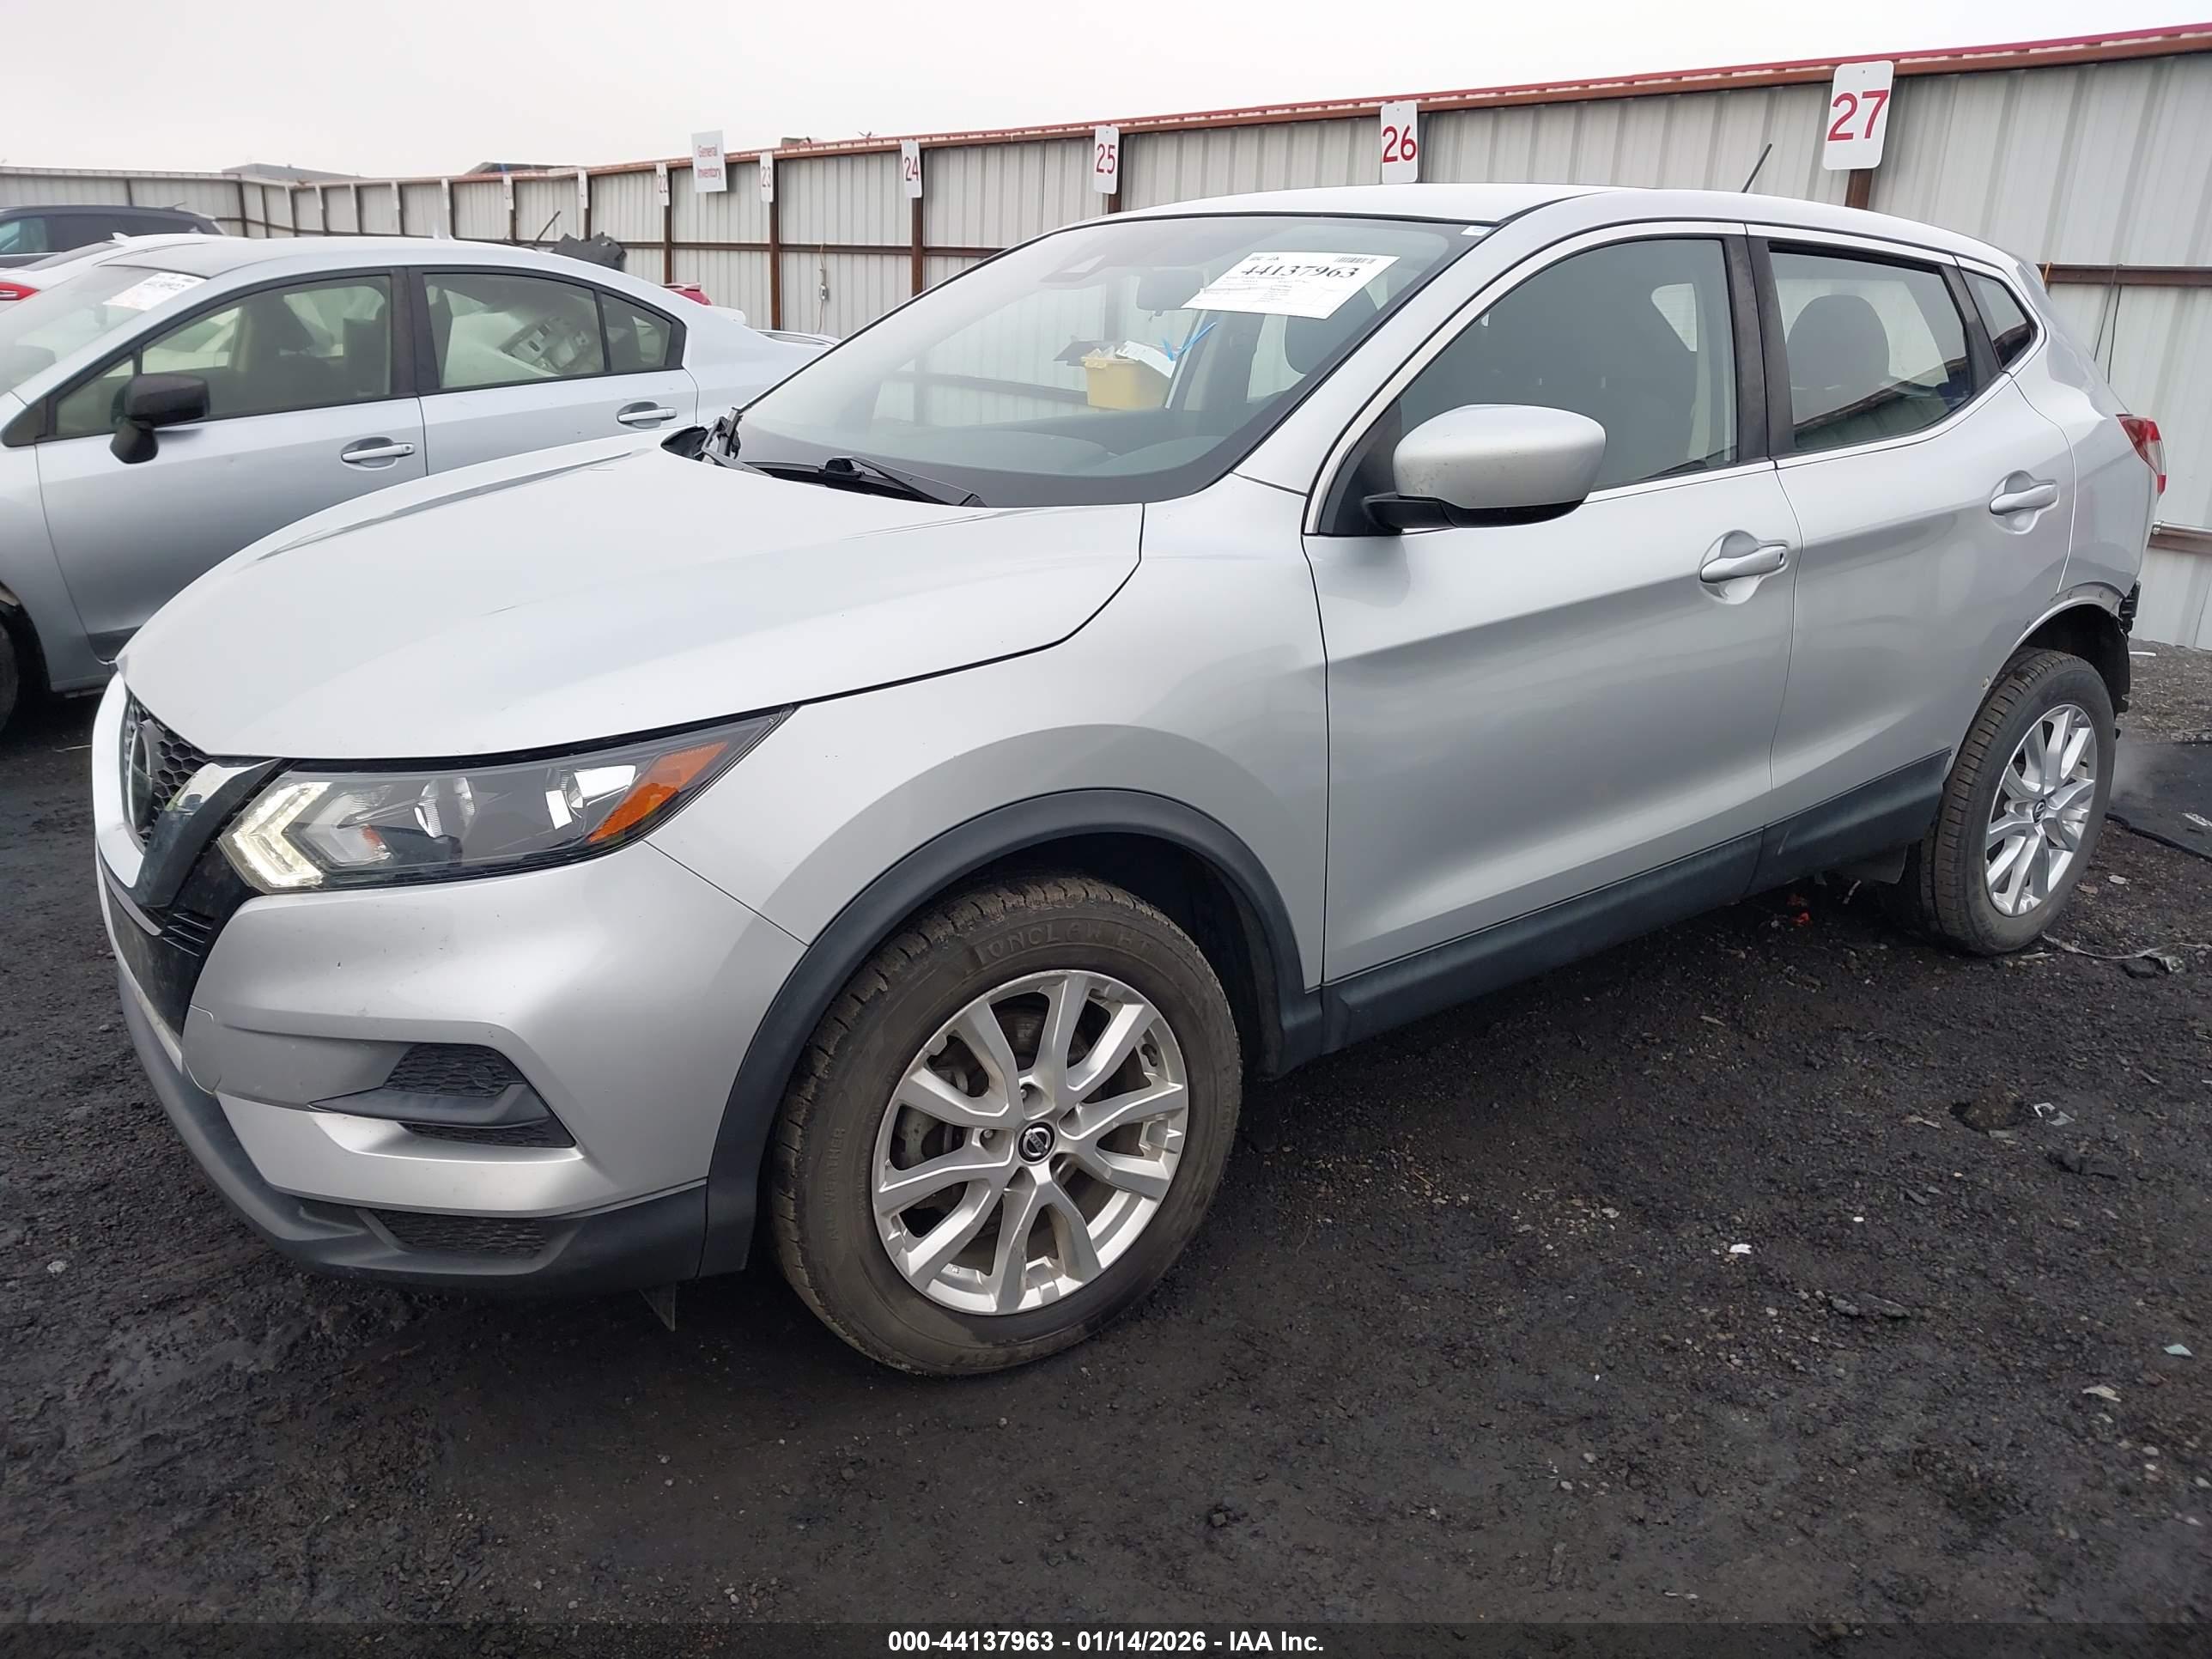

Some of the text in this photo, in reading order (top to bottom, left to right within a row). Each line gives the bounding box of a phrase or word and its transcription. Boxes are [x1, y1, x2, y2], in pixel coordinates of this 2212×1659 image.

[1827, 89, 1889, 141] 27
[1382, 125, 1416, 163] 26
[904, 155, 919, 181] 24
[1097, 143, 1115, 174] 25
[761, 166, 771, 188] 23
[1241, 264, 1360, 279] 44137963
